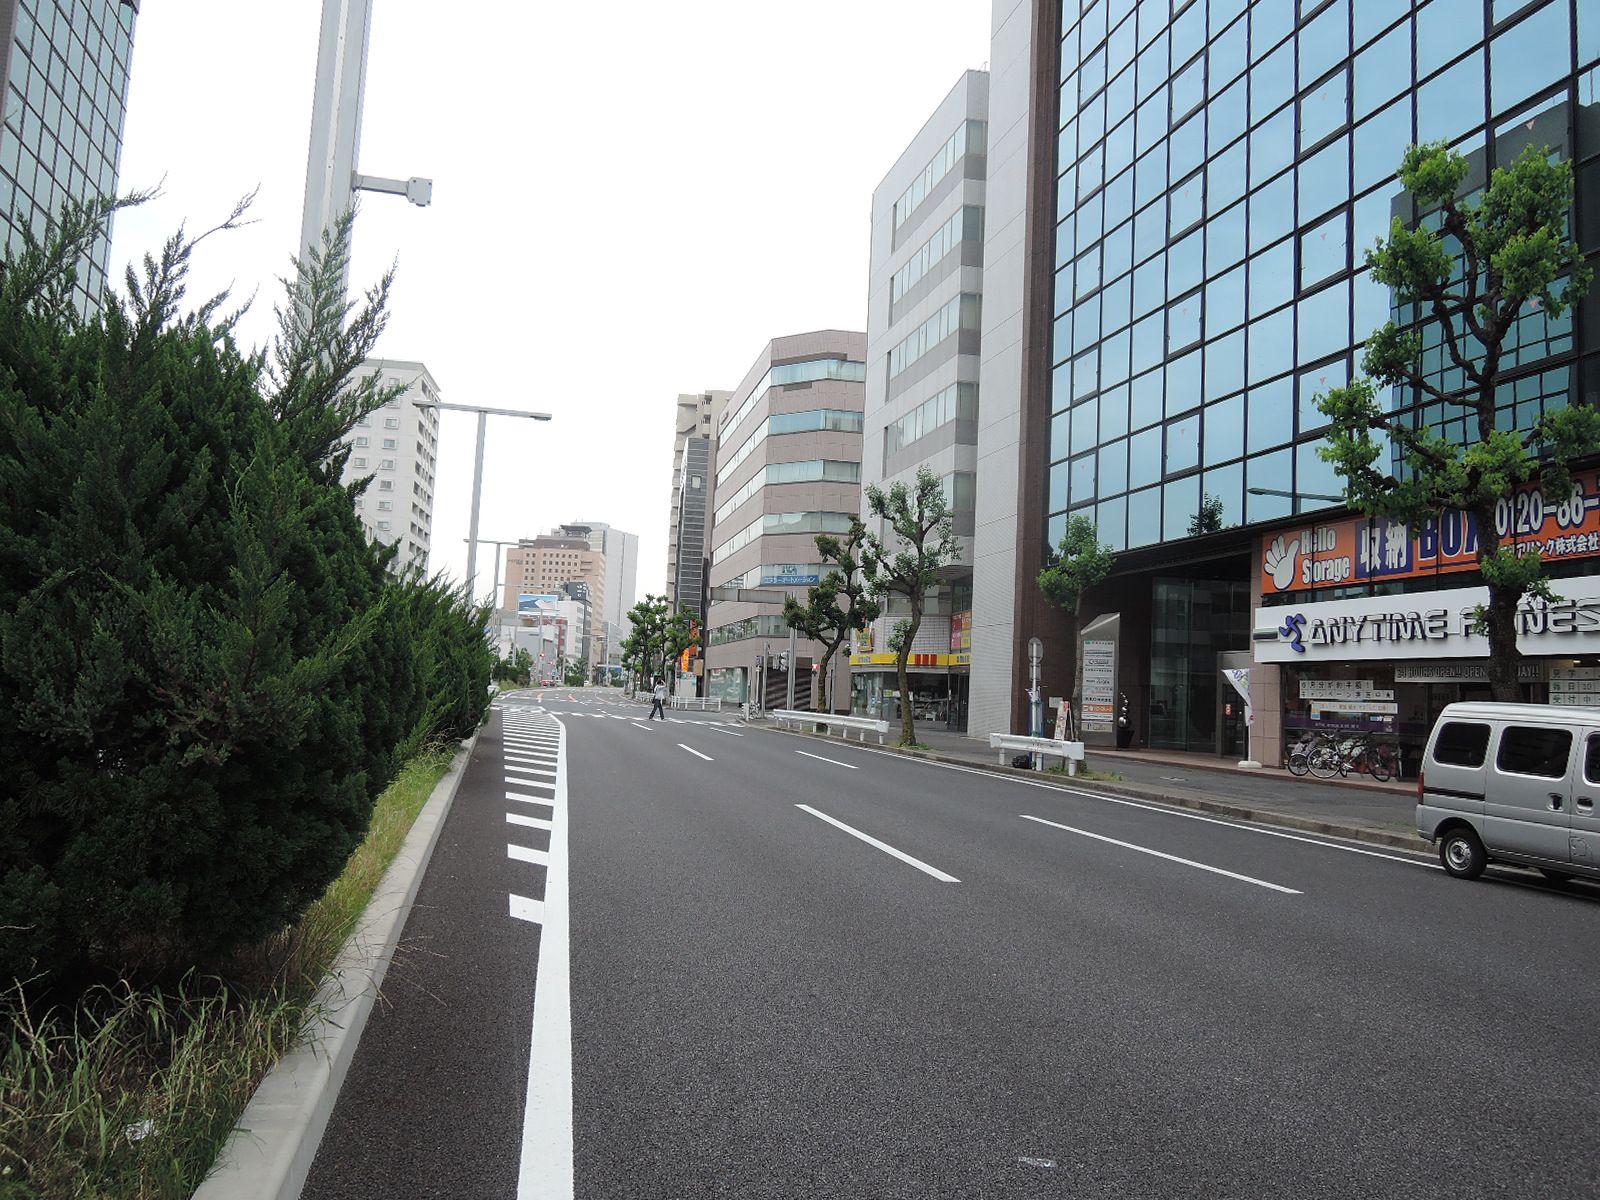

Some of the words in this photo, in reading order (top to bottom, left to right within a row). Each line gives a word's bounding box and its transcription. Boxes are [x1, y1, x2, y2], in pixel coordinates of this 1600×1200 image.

[1301, 527, 1336, 555] Hello
[1360, 520, 1407, 573] 収納
[1500, 532, 1599, 559] アリンク株式会社
[1302, 556, 1350, 584] Storage
[1308, 609, 1448, 645] ANYTIME
[1459, 597, 1600, 637] FNES
[1408, 666, 1434, 678] HOURS
[1435, 665, 1462, 678] OPEN!!
